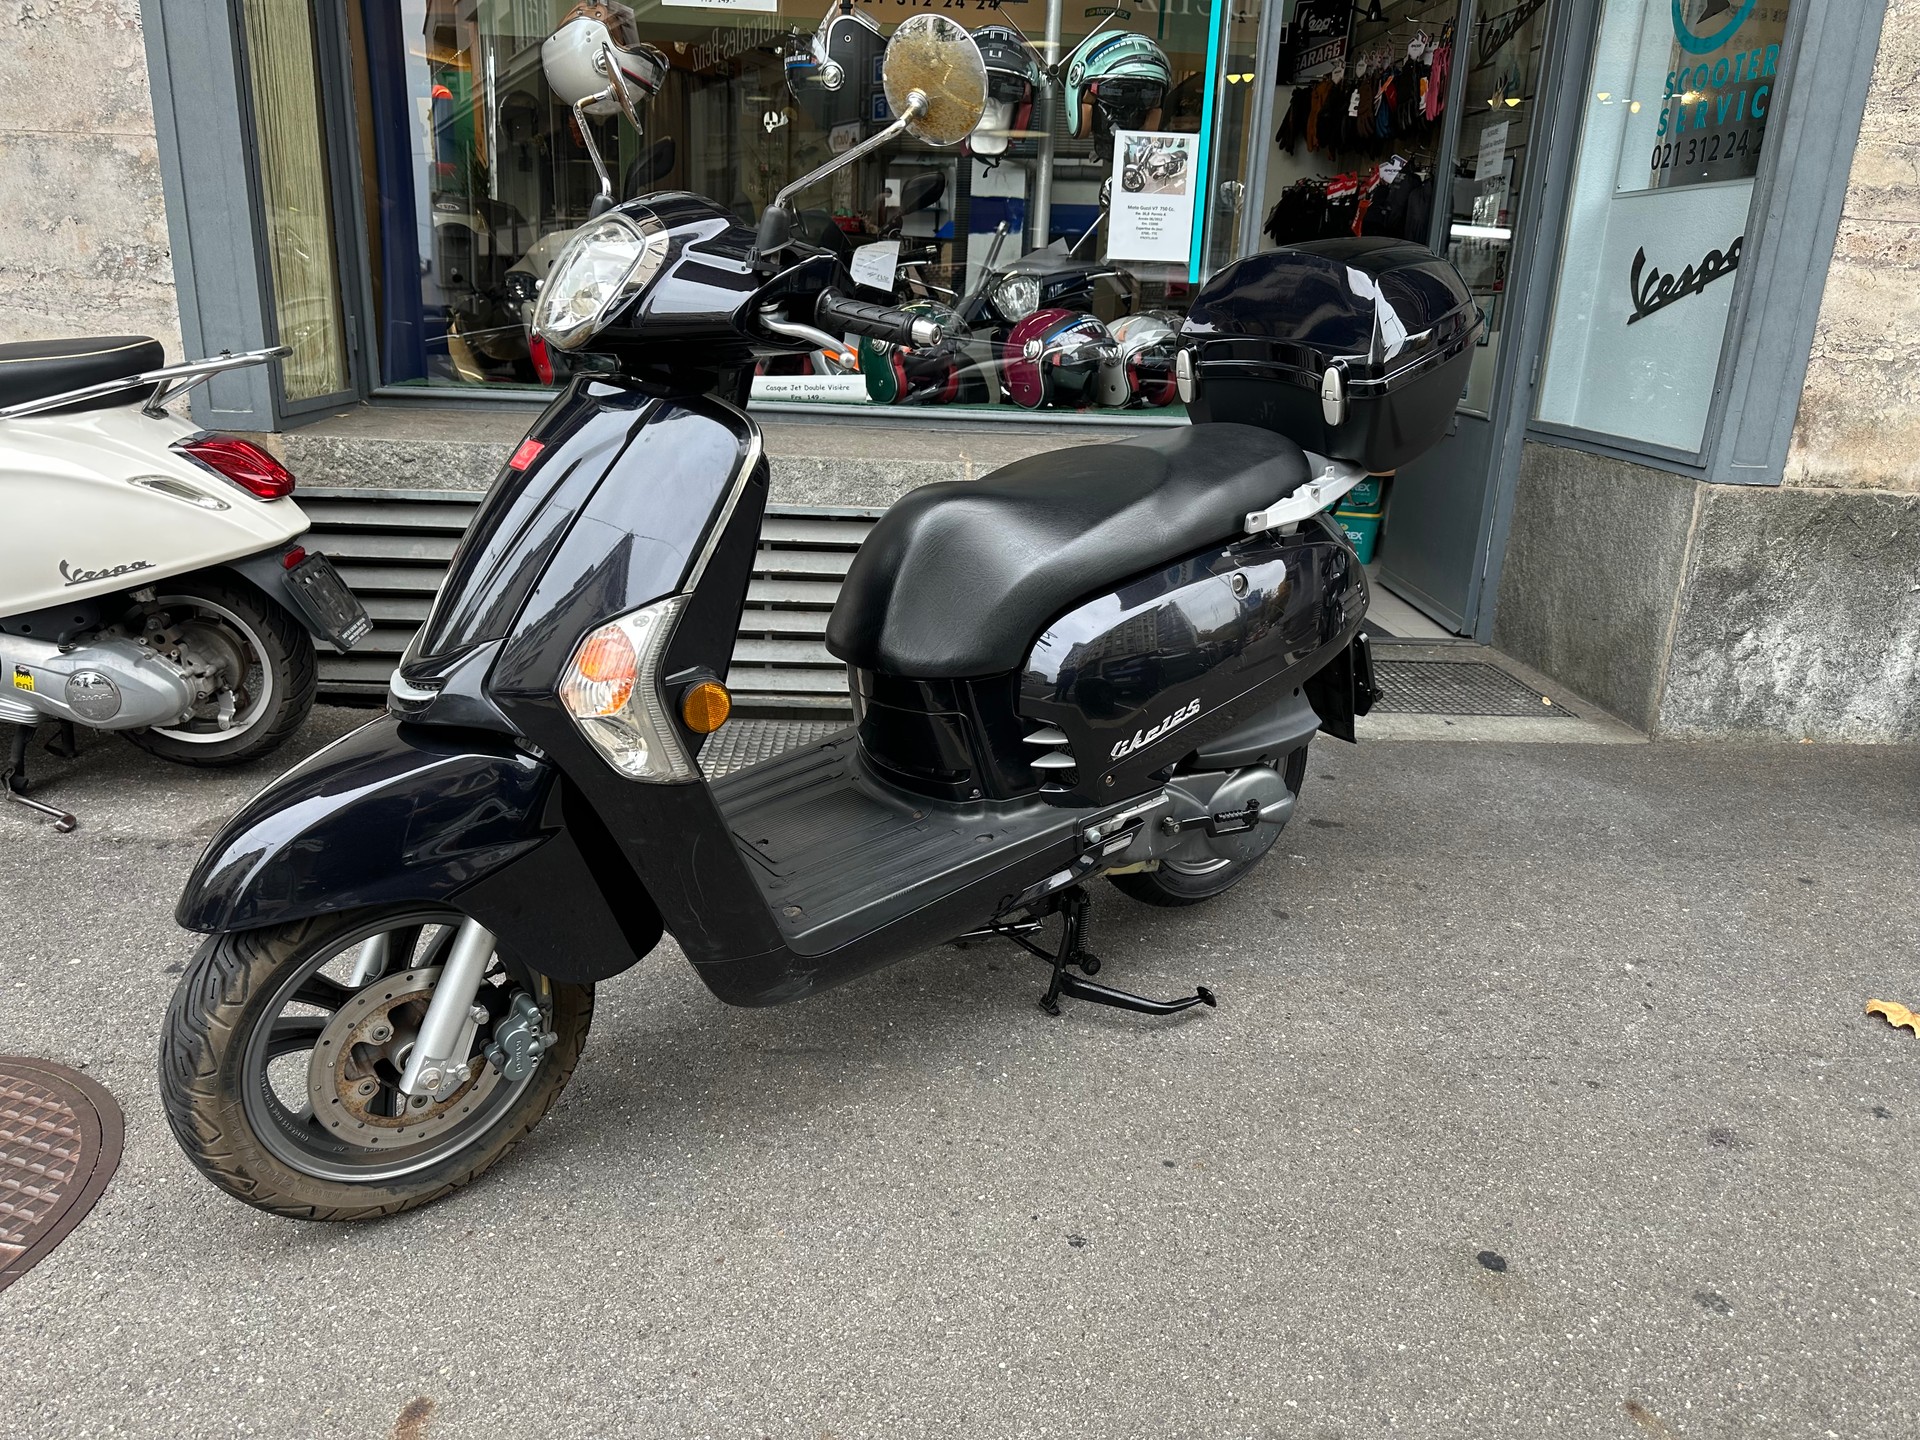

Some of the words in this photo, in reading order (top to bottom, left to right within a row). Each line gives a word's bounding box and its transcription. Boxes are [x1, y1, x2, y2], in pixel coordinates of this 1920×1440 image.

[1664, 43, 1780, 100] SCOOTER
[1651, 140, 1681, 171] 021
[1685, 131, 1720, 166] 312
[1723, 129, 1750, 160] 24
[765, 384, 788, 393] Casque
[828, 383, 850, 391] Visière
[59, 558, 157, 588] Vespa
[15, 681, 33, 692] eni
